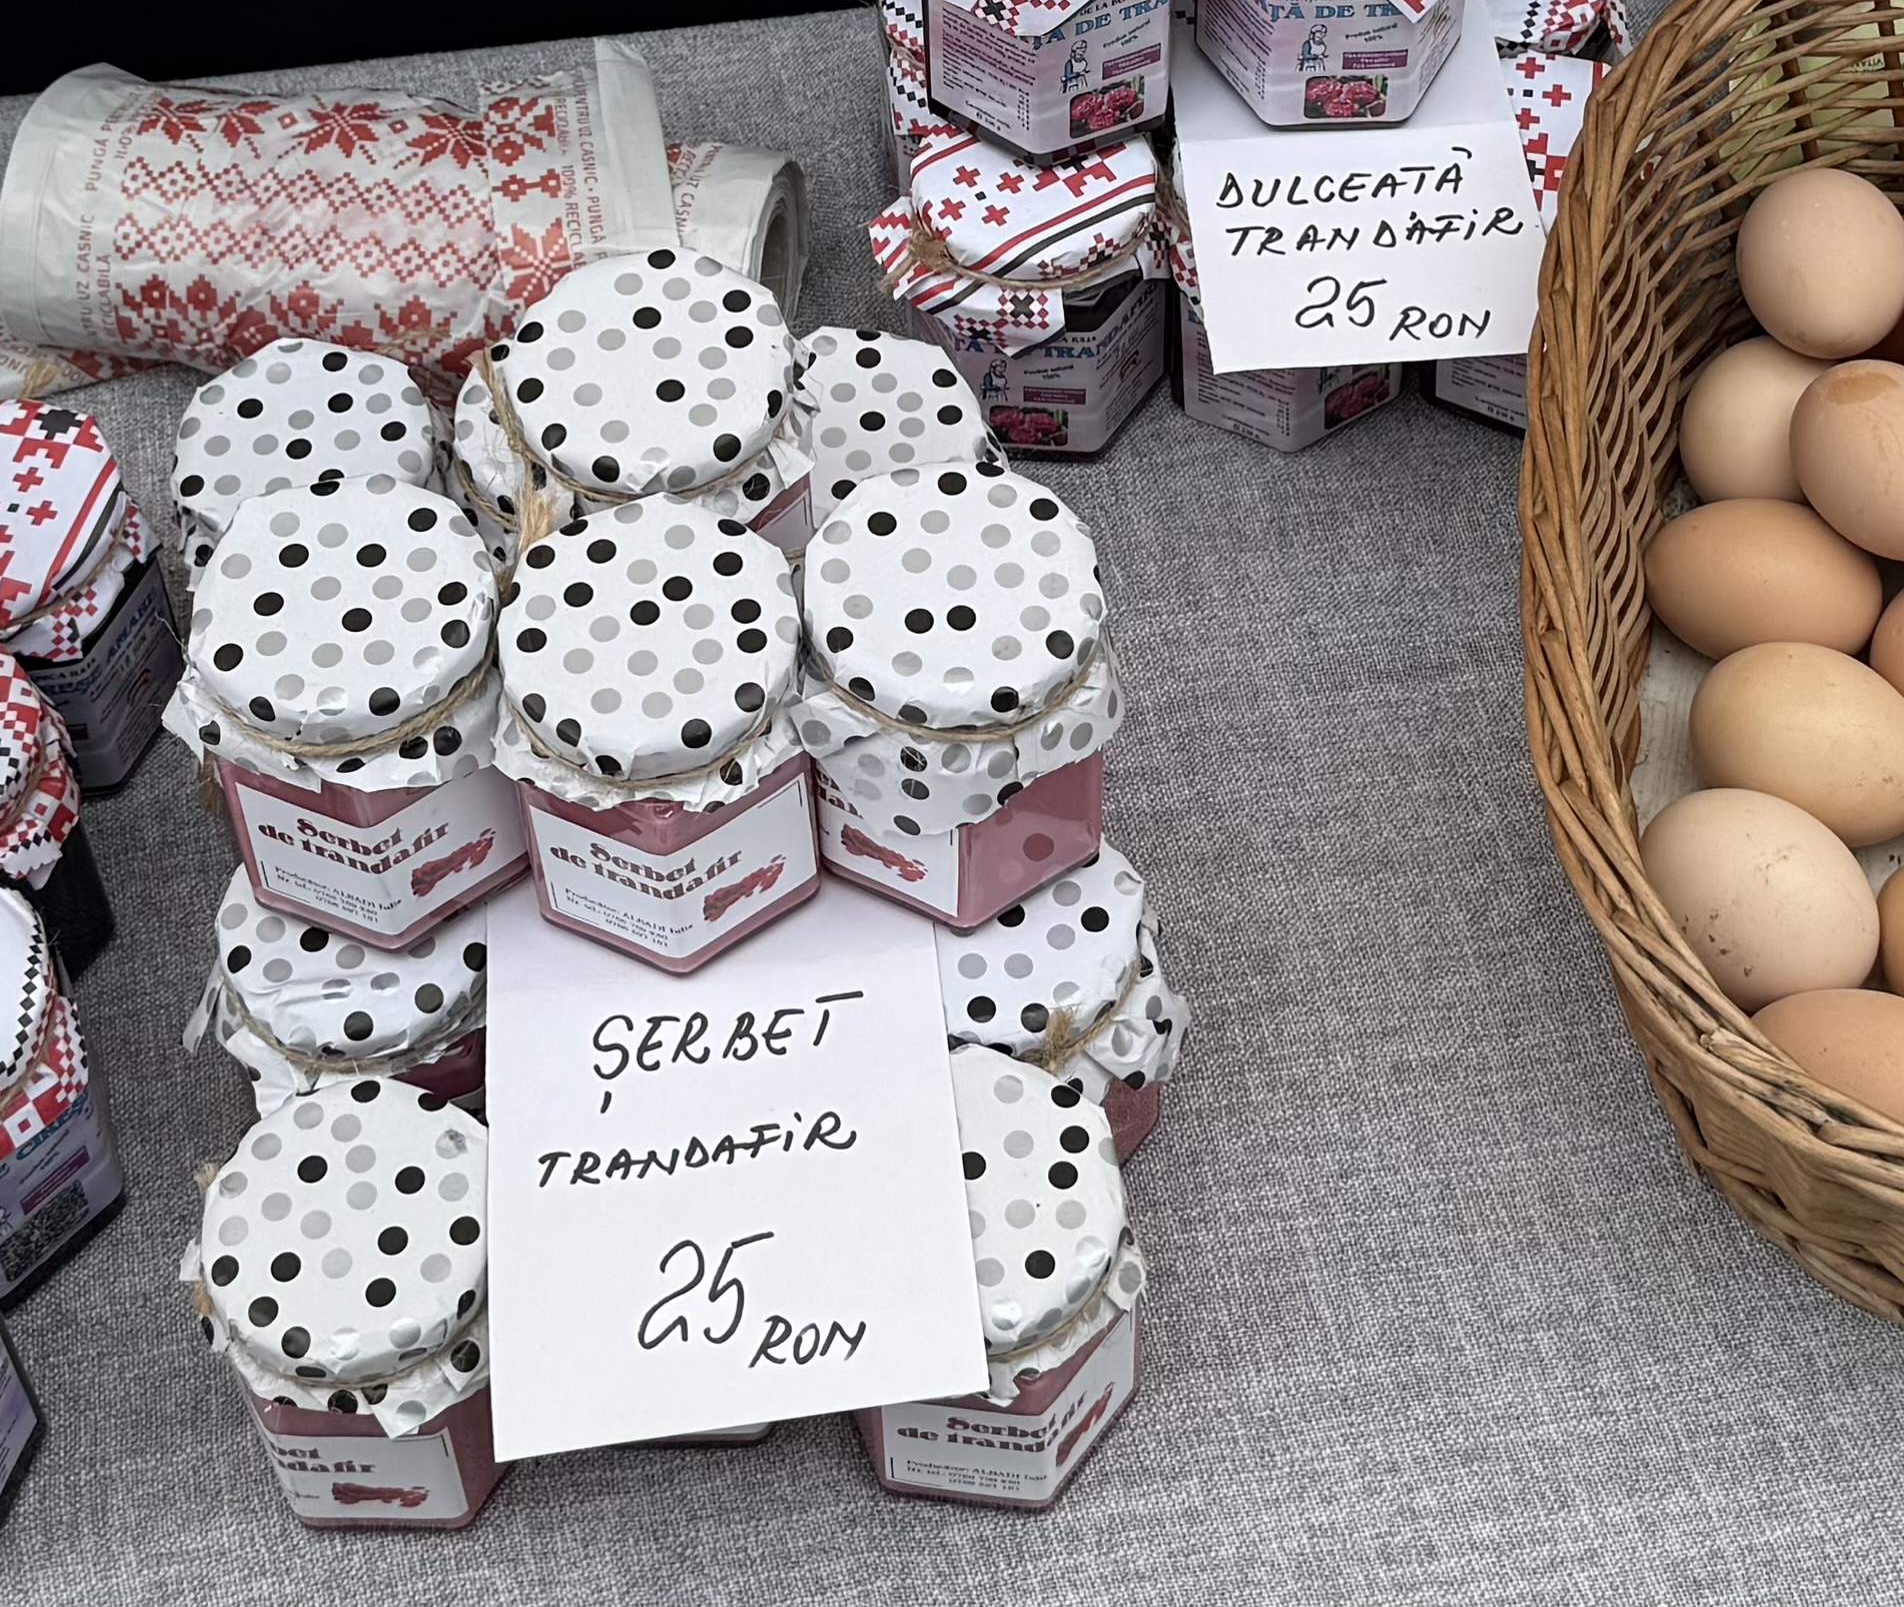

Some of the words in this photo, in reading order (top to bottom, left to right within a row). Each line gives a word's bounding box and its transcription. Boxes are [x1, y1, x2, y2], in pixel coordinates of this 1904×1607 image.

[1294, 275, 1388, 330] 25
[1388, 305, 1492, 342] RON
[257, 823, 296, 848] de
[300, 821, 450, 876] trandafir
[549, 844, 588, 870] de
[593, 849, 744, 901] trandafir
[592, 990, 866, 1115] ȘERBET
[537, 1111, 859, 1189] TRANDAFIR
[637, 1231, 776, 1352] 25
[748, 1314, 868, 1370] RON
